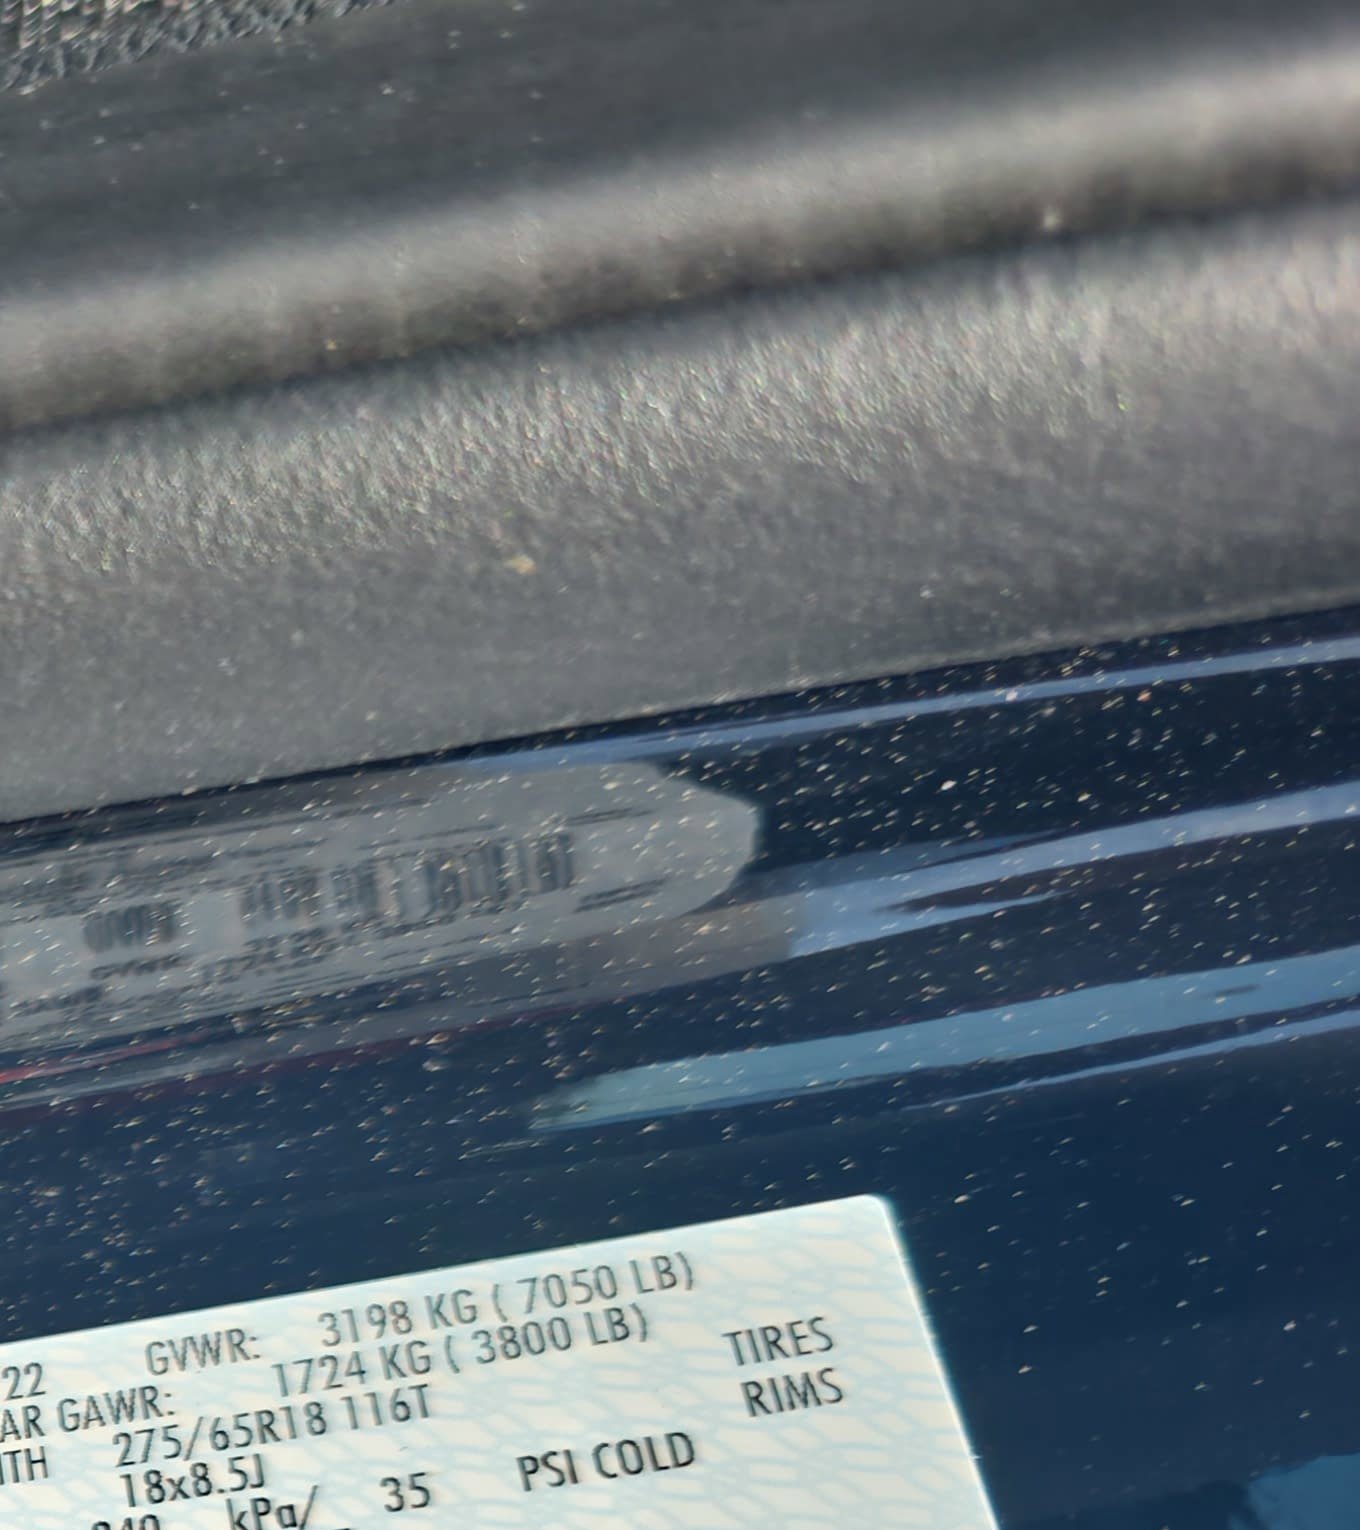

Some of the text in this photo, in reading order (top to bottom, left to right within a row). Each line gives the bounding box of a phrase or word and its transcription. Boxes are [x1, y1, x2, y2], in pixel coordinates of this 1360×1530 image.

[56, 1386, 175, 1433] GAWR:
[271, 1354, 367, 1398] 1724
[379, 1342, 433, 1382] KG
[474, 1317, 572, 1365] 3800
[584, 1304, 651, 1347] LB)
[145, 1329, 261, 1376] GVWR:
[318, 1300, 413, 1350] 3198
[424, 1289, 479, 1331] KG
[522, 1265, 619, 1315] 7050
[629, 1251, 696, 1294] LB)
[112, 1401, 327, 1468] 275/65R18
[340, 1383, 430, 1430] 116T
[723, 1317, 834, 1368] TIRES
[119, 1367, 844, 1507] 18x8.5J RIMS
[380, 1472, 431, 1513] 35
[516, 1450, 579, 1492] PSI
[592, 1432, 696, 1480] COLD
